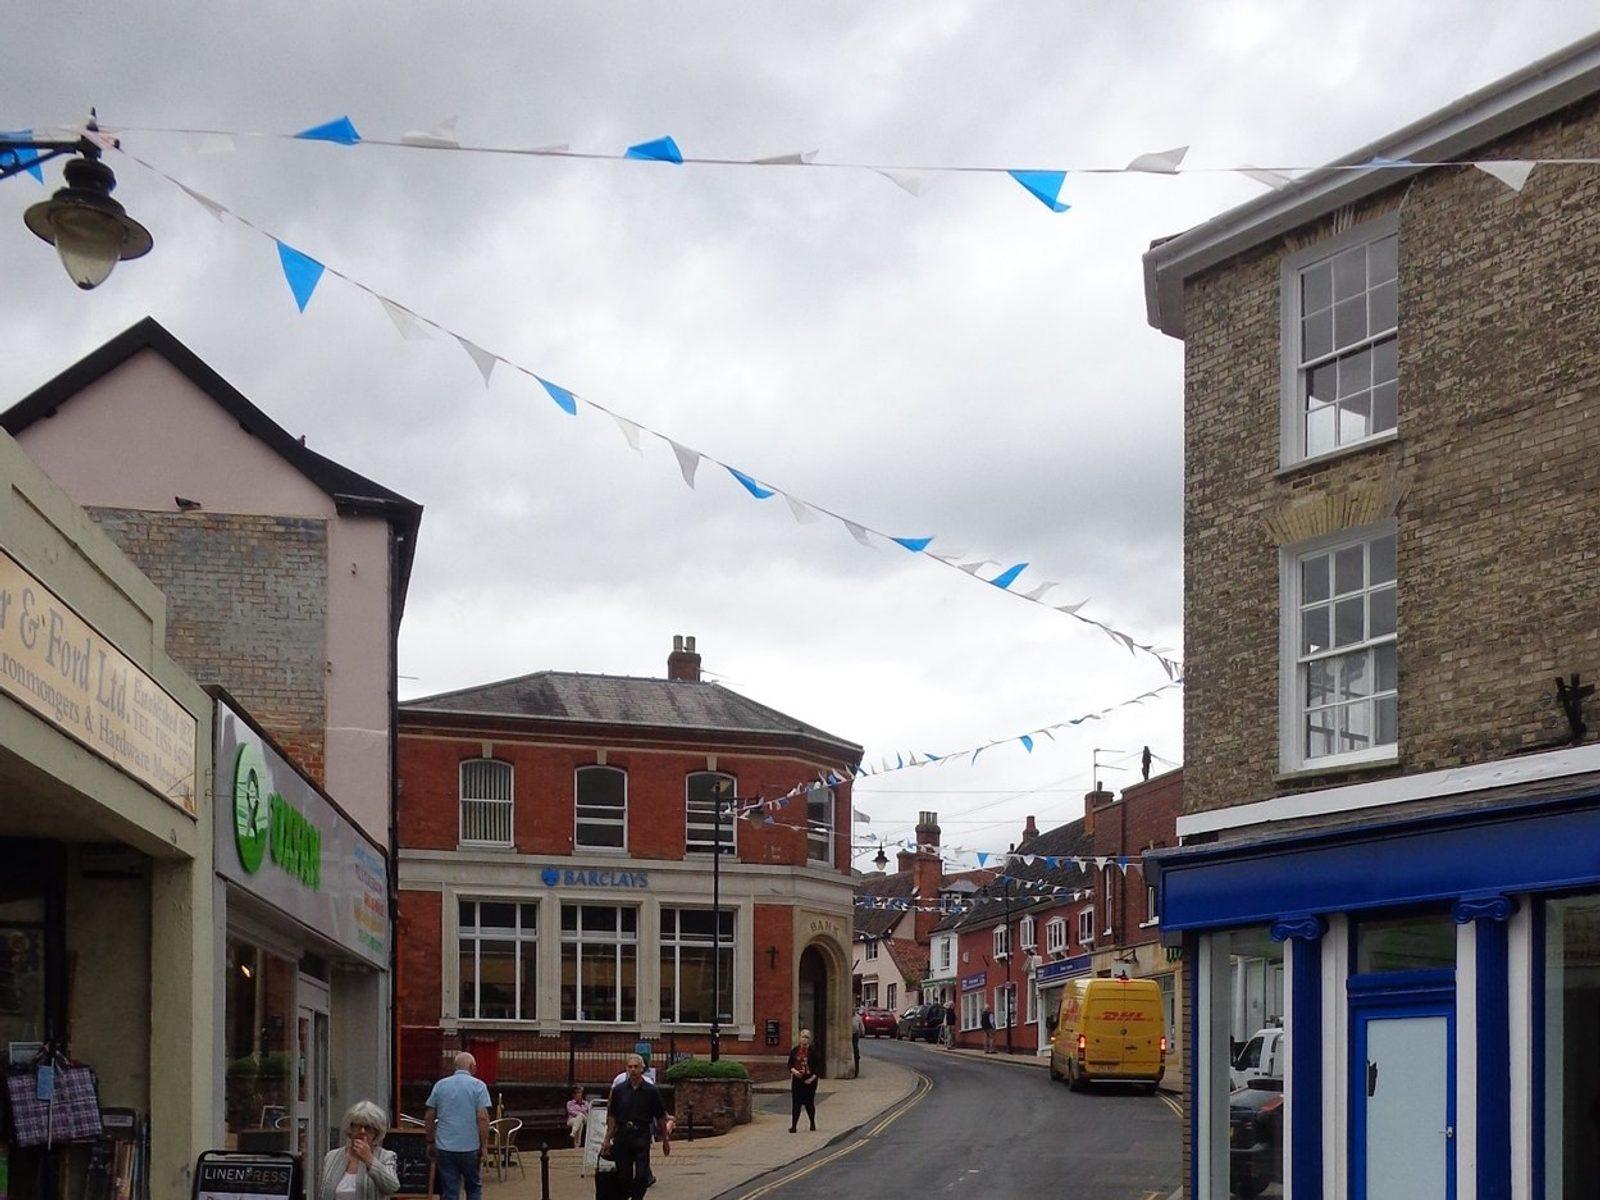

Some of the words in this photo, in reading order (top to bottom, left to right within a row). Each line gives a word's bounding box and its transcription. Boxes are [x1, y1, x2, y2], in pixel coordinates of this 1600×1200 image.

[20, 588, 39, 650] &
[45, 607, 91, 692] Ford
[97, 650, 130, 725] Ltd.
[0, 652, 80, 724] ronmongers
[85, 705, 94, 735] &
[99, 714, 150, 773] Hardware
[564, 868, 648, 888] BARCLAYS
[809, 920, 840, 937] BANK
[1102, 1010, 1145, 1022] DHL
